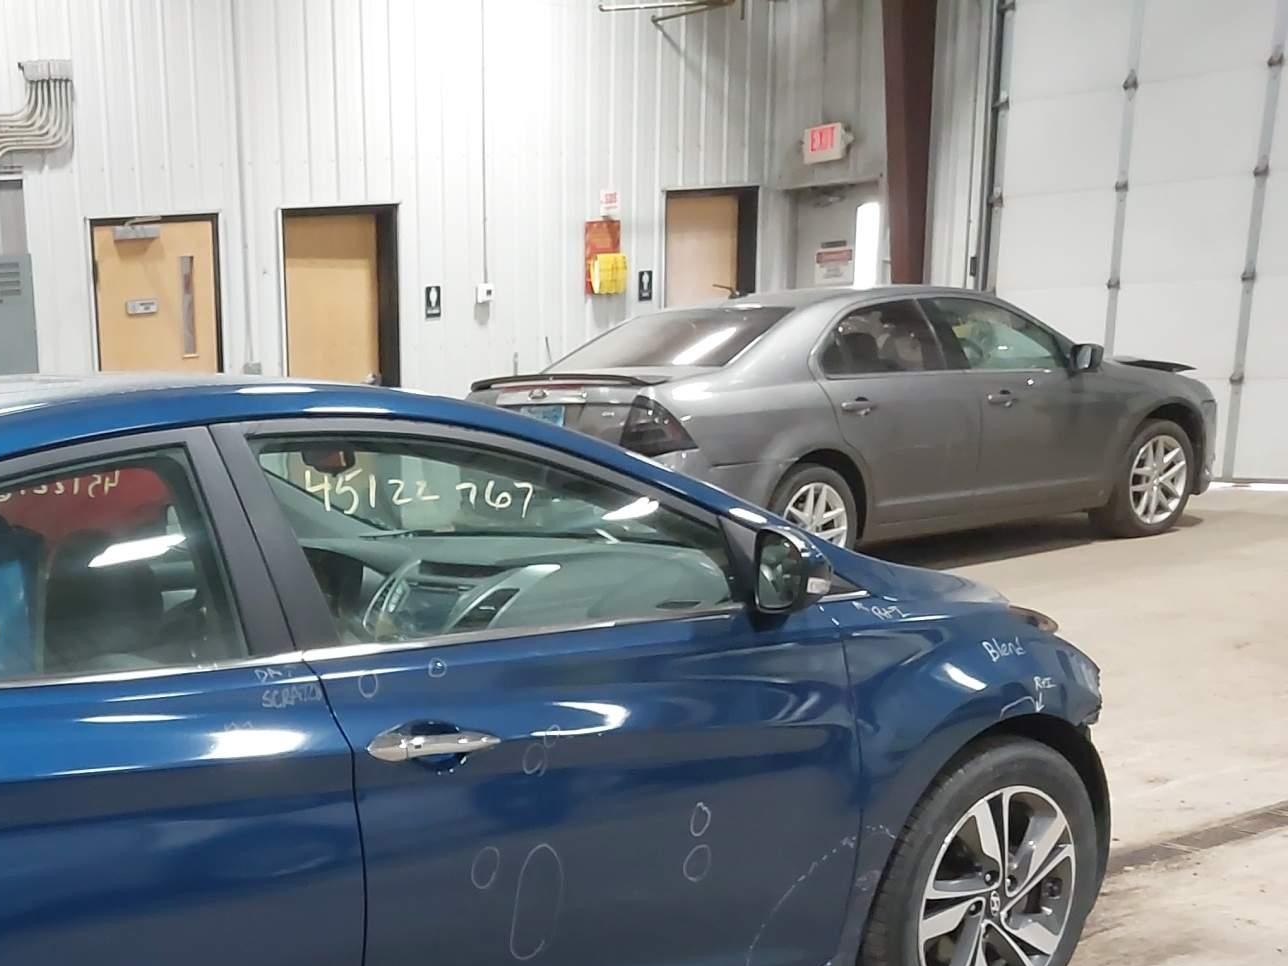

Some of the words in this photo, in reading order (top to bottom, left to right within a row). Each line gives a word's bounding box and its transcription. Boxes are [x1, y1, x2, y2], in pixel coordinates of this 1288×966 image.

[303, 468, 441, 516] 45122
[455, 479, 536, 519] 767
[981, 636, 1027, 664] Blend
